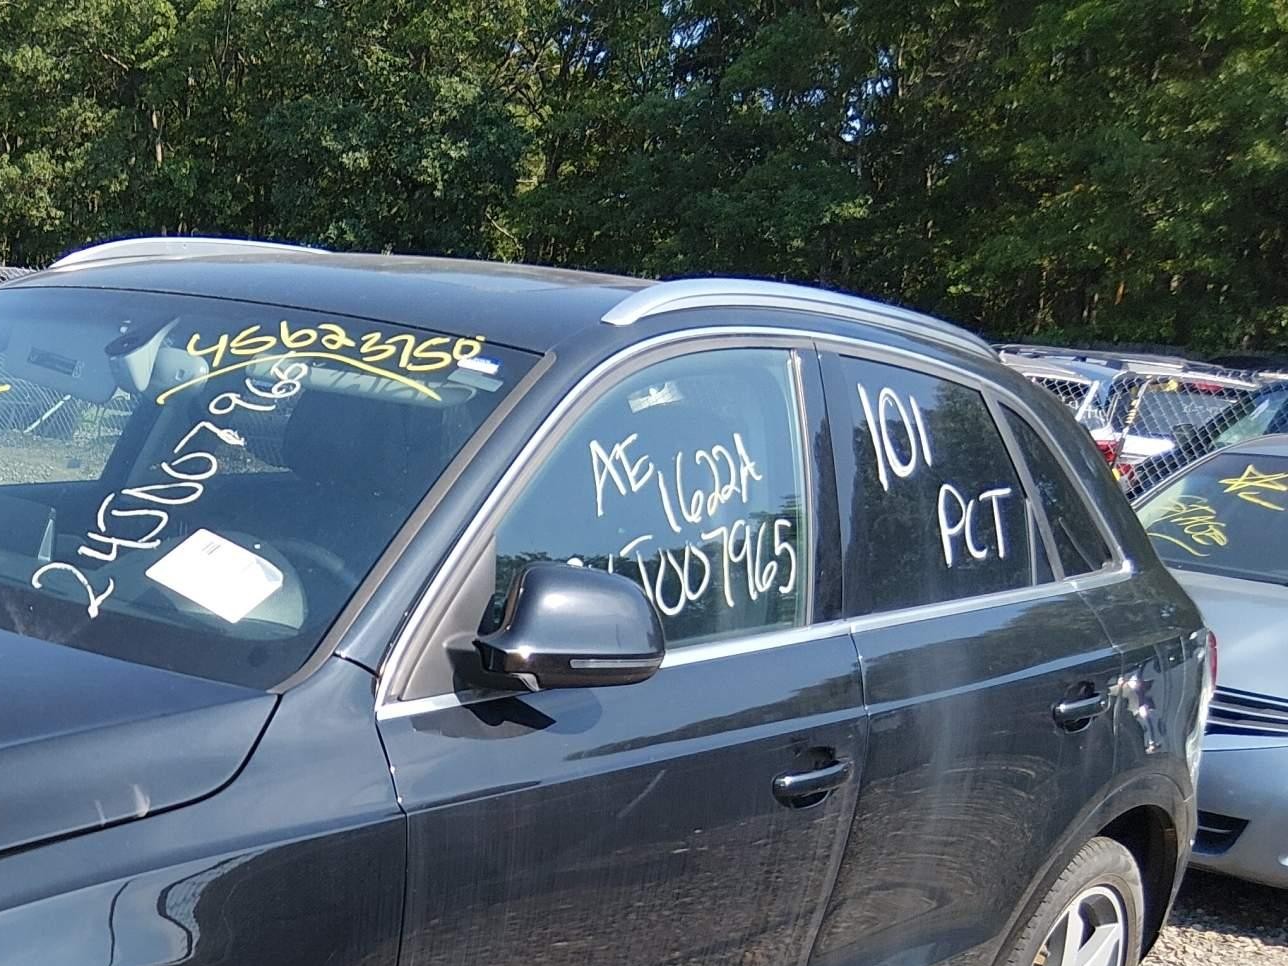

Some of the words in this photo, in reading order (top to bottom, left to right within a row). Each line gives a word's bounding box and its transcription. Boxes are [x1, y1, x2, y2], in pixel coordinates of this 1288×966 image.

[589, 433, 654, 517] AE
[857, 383, 932, 491] 101
[937, 483, 1012, 568] PCT
